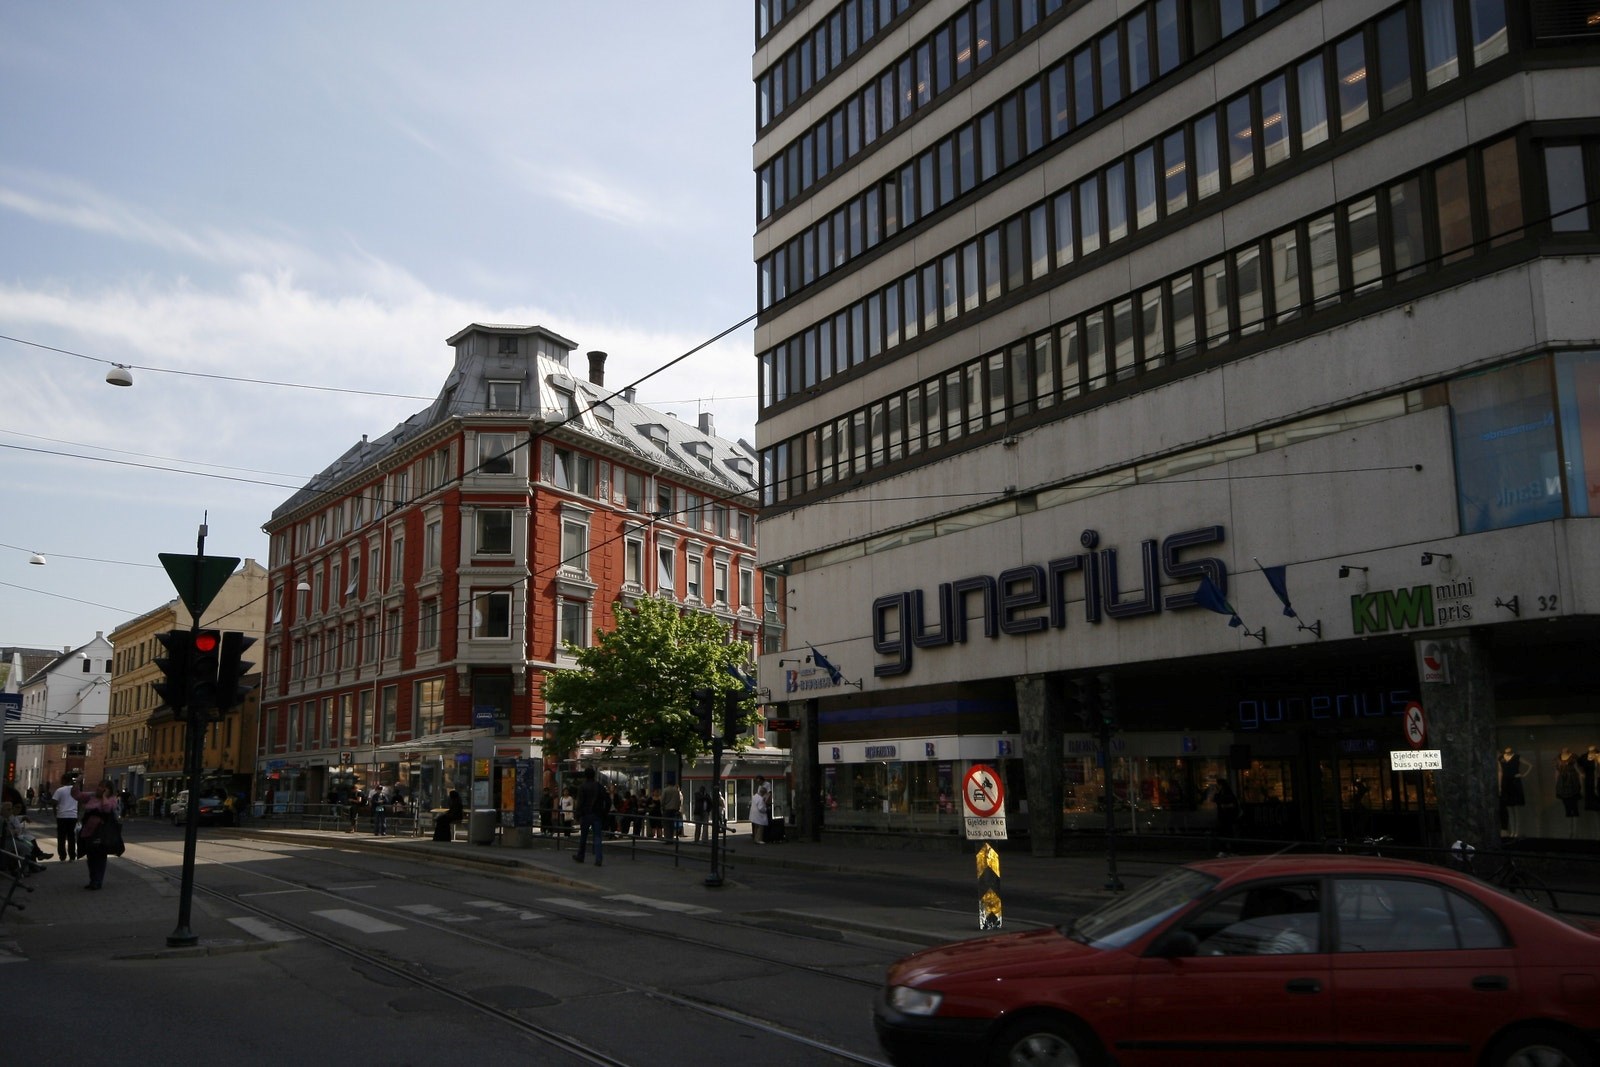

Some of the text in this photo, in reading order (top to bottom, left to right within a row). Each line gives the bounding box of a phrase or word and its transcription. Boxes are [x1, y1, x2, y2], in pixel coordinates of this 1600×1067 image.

[1436, 577, 1473, 600] mini
[873, 525, 1227, 677] gunerius
[1351, 584, 1435, 634] KIWI
[1538, 595, 1558, 611] 32
[1438, 602, 1472, 626] pris
[1238, 689, 1410, 732] gunerius
[1393, 752, 1420, 761] Gjelder
[967, 819, 988, 827] Gjelder
